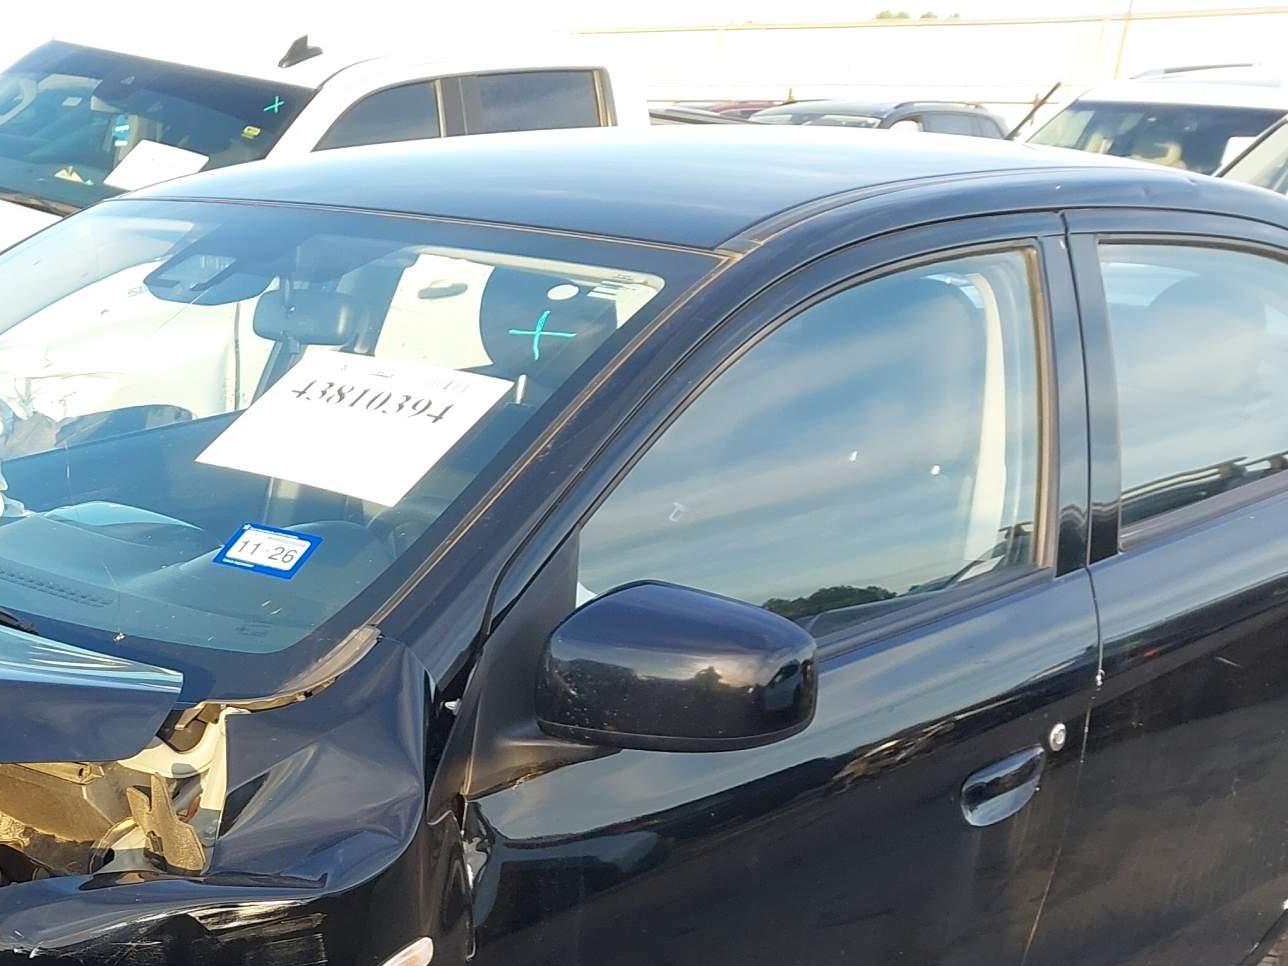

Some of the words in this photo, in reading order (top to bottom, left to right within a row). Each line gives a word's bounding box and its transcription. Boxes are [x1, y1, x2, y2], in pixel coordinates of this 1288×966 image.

[292, 379, 454, 423] 43810394
[237, 539, 263, 556] 11
[267, 546, 299, 564] 26
